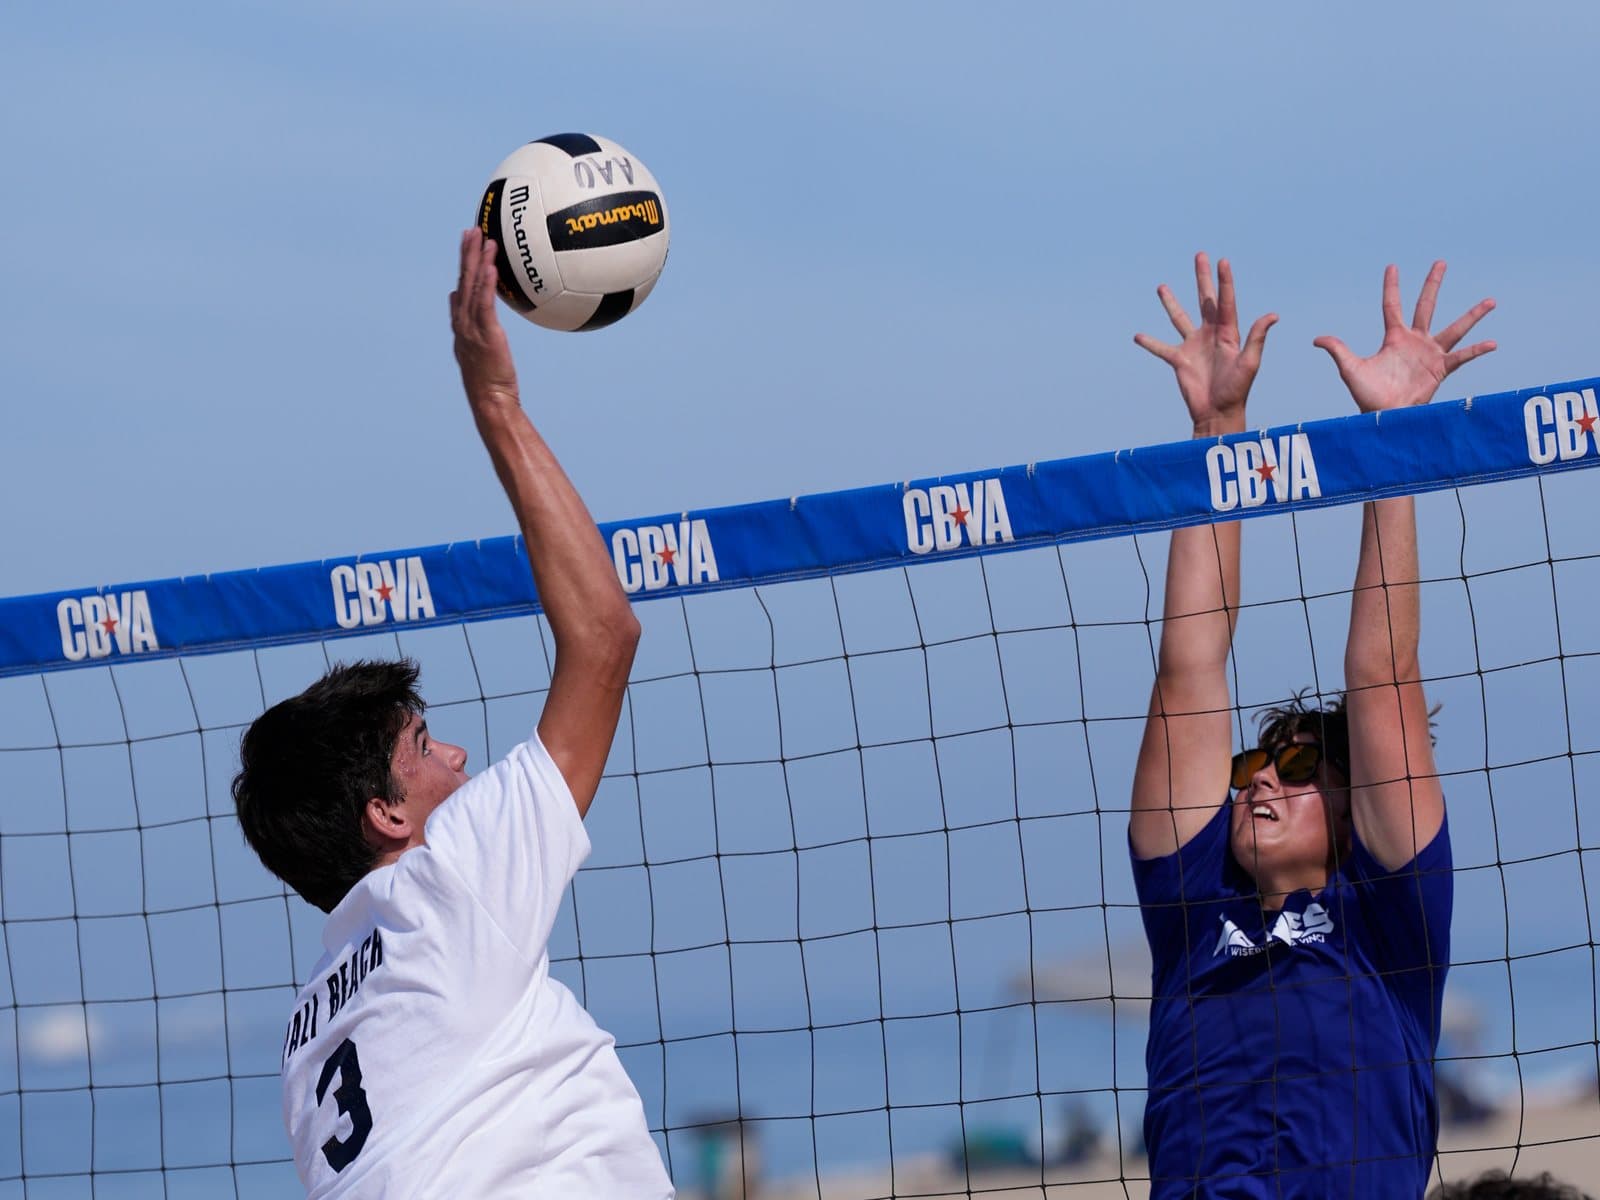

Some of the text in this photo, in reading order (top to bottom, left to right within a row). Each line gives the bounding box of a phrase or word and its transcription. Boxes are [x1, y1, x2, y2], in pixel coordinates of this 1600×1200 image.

[573, 156, 635, 189] AAU
[509, 185, 545, 294] Miramar
[565, 199, 660, 232] Miramar
[1523, 387, 1600, 465] CBV
[1206, 433, 1321, 512] CBVA
[902, 478, 1016, 555] CBVA
[331, 556, 436, 629] CBVA
[611, 518, 720, 594] CBVA
[57, 589, 160, 662] CBVA
[327, 926, 384, 1024] BEACH
[315, 1037, 374, 1174] 3
